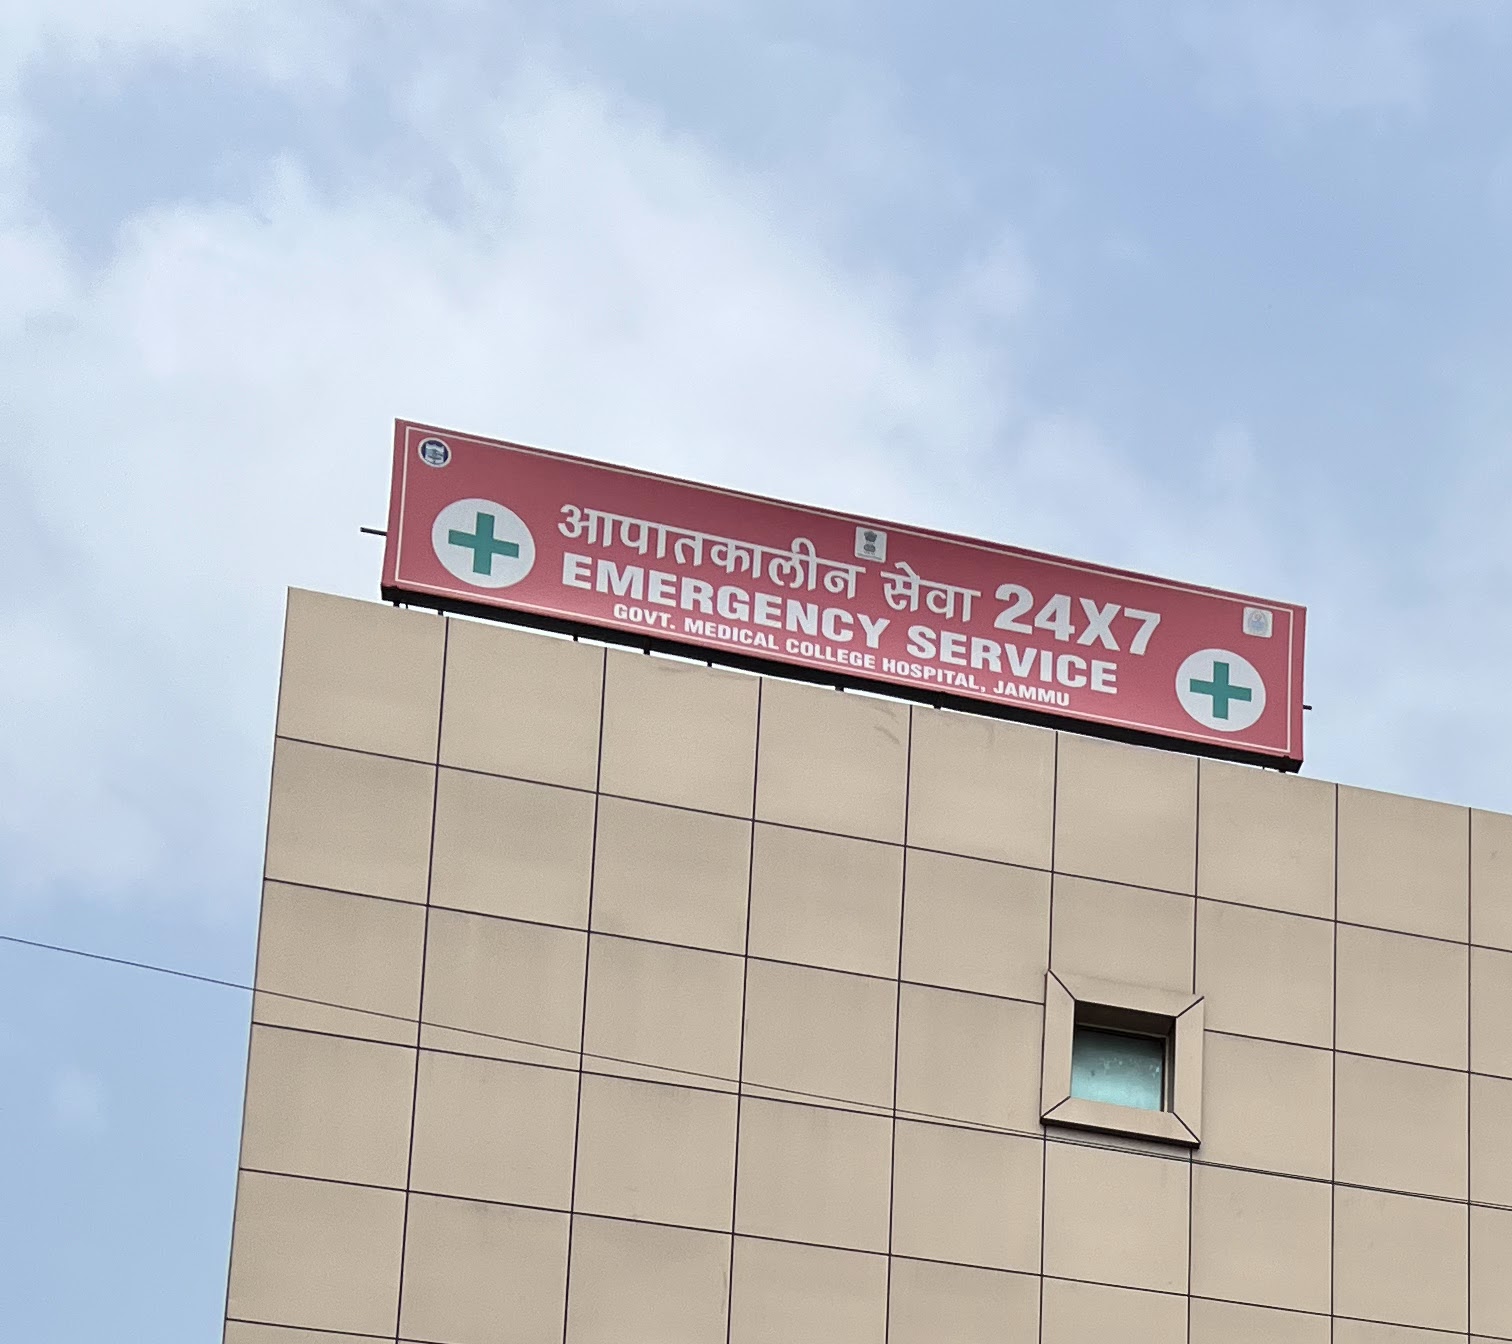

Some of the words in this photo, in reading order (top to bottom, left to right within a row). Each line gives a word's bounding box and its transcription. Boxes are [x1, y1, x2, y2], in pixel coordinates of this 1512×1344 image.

[557, 503, 867, 600] आपातकालीन
[880, 561, 982, 623] सेवा
[993, 583, 1162, 656] 24X7
[561, 551, 891, 649] EMERGENCY
[906, 623, 1118, 694] SERVICE
[613, 603, 676, 630] GOVT.
[684, 617, 780, 651] MEDICAL
[785, 637, 876, 670] COLLEGE
[882, 657, 986, 693] HOSPITAL,
[992, 679, 1070, 707] JAMMU
